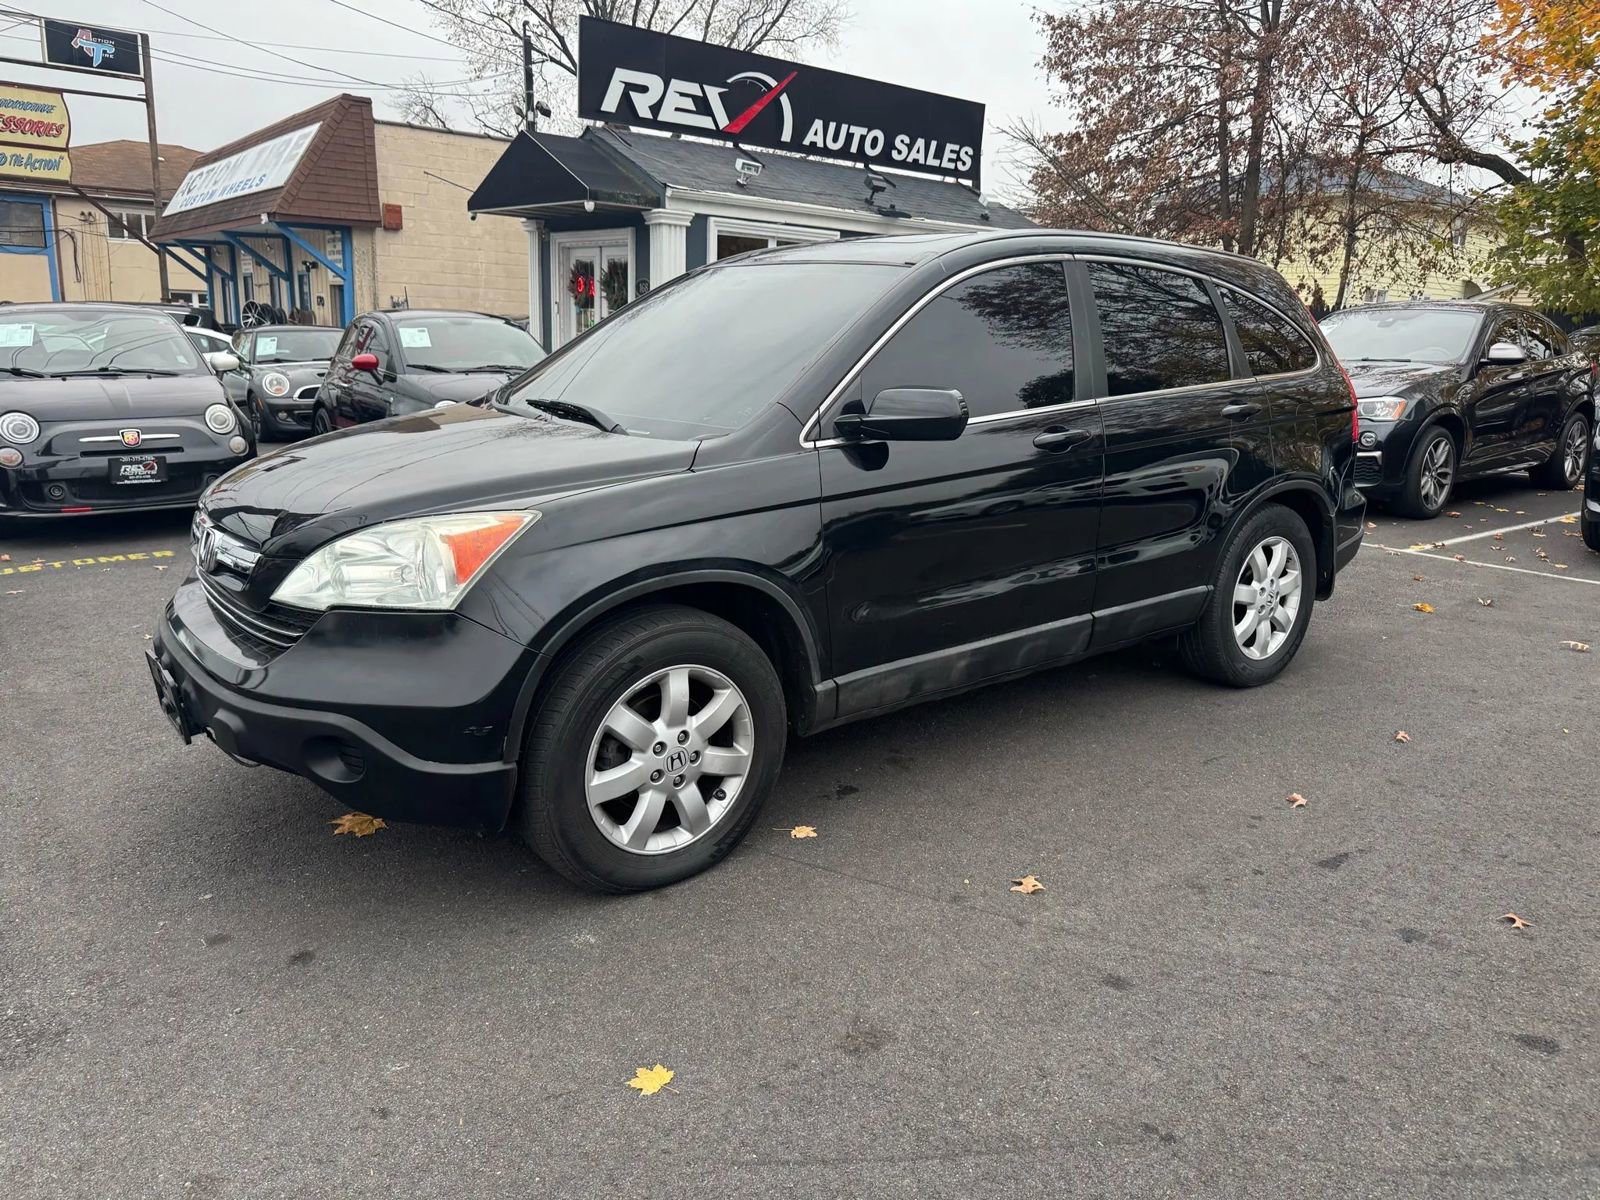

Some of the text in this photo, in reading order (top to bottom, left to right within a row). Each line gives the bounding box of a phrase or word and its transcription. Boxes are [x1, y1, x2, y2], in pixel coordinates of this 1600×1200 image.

[601, 67, 798, 137] REV
[803, 118, 974, 172] AUTO SALES
[179, 174, 267, 209] CUSTOM WHEELS
[0, 551, 176, 575] USTOMER
